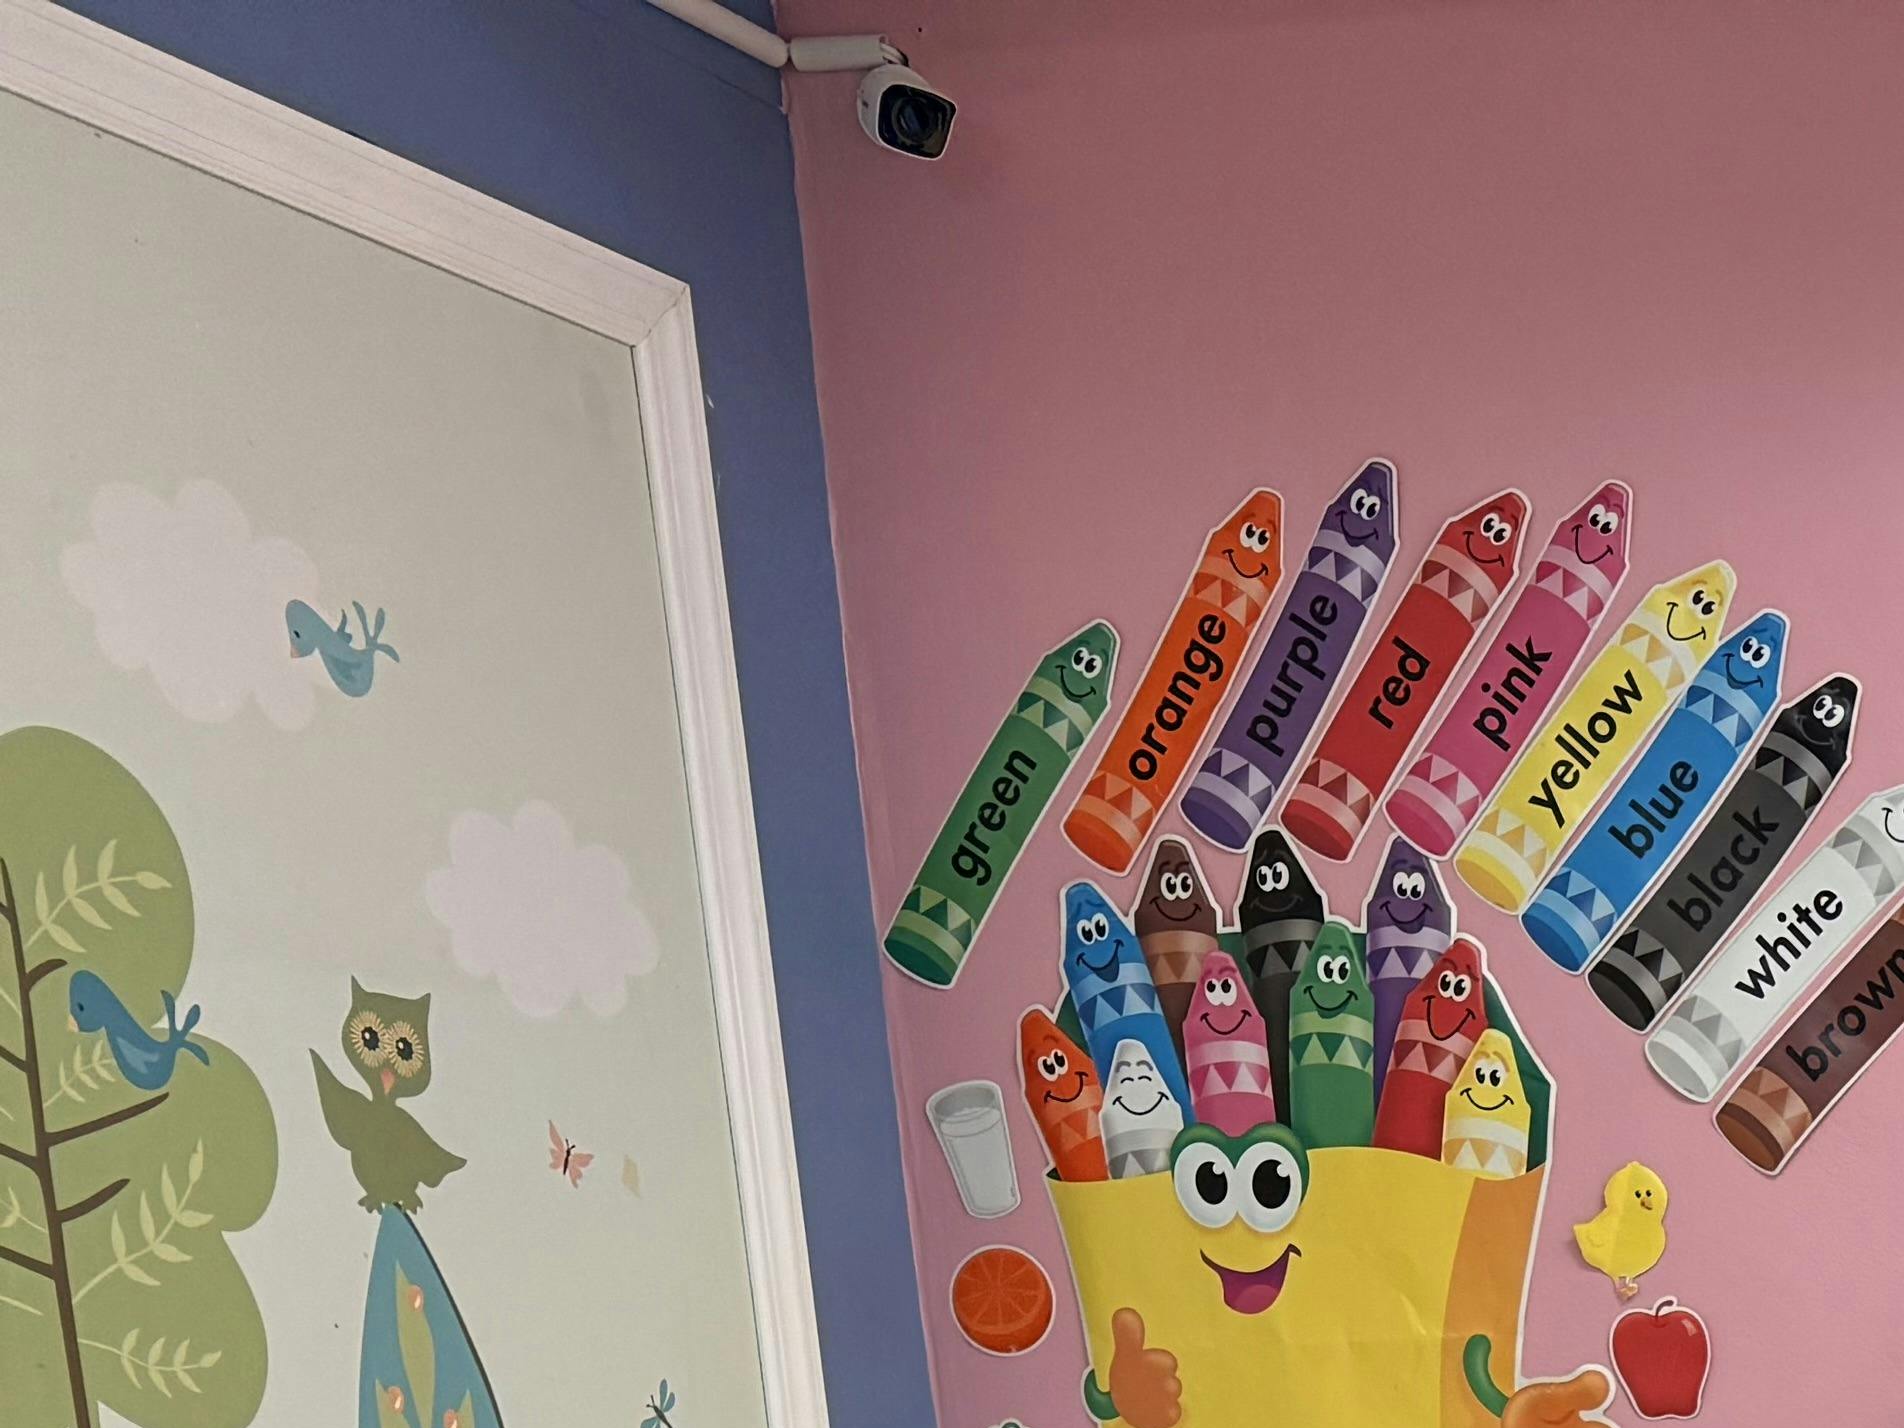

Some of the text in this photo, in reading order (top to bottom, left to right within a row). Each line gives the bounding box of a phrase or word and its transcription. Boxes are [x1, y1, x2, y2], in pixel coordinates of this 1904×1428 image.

[1125, 611, 1227, 782] orange
[1246, 592, 1341, 757] purple
[1367, 636, 1429, 730] red
[1473, 634, 1553, 751] pink
[1527, 669, 1647, 825] yellow
[1607, 756, 1700, 860] blue
[951, 747, 1039, 886] green
[1667, 803, 1781, 934] black
[1733, 886, 1845, 1002] white
